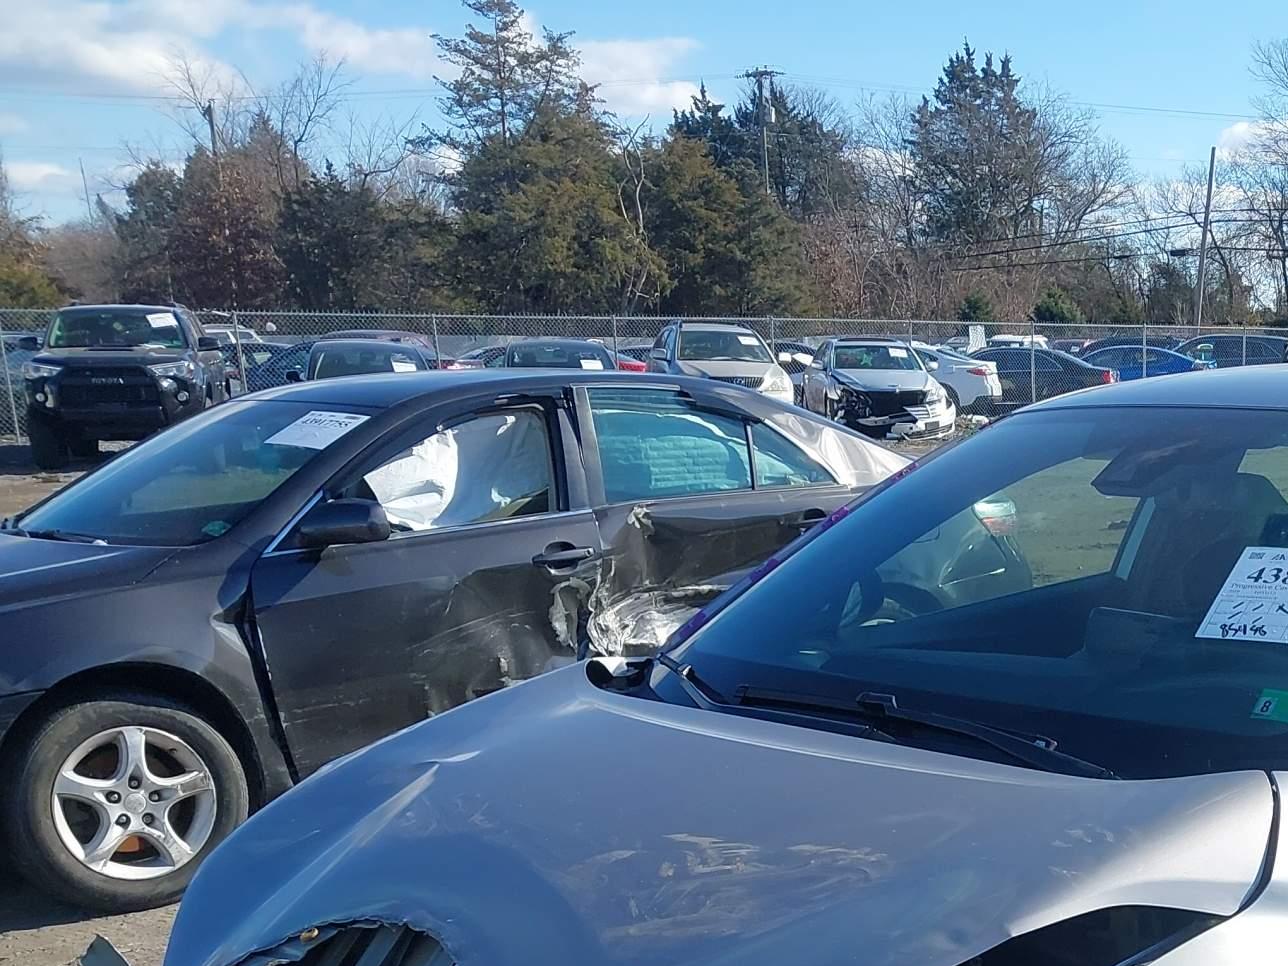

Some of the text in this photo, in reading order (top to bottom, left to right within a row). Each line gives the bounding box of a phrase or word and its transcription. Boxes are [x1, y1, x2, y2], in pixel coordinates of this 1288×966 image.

[91, 377, 124, 385] TOYOTA
[1231, 583, 1273, 591] Progressive
[1260, 700, 1272, 713] 8
